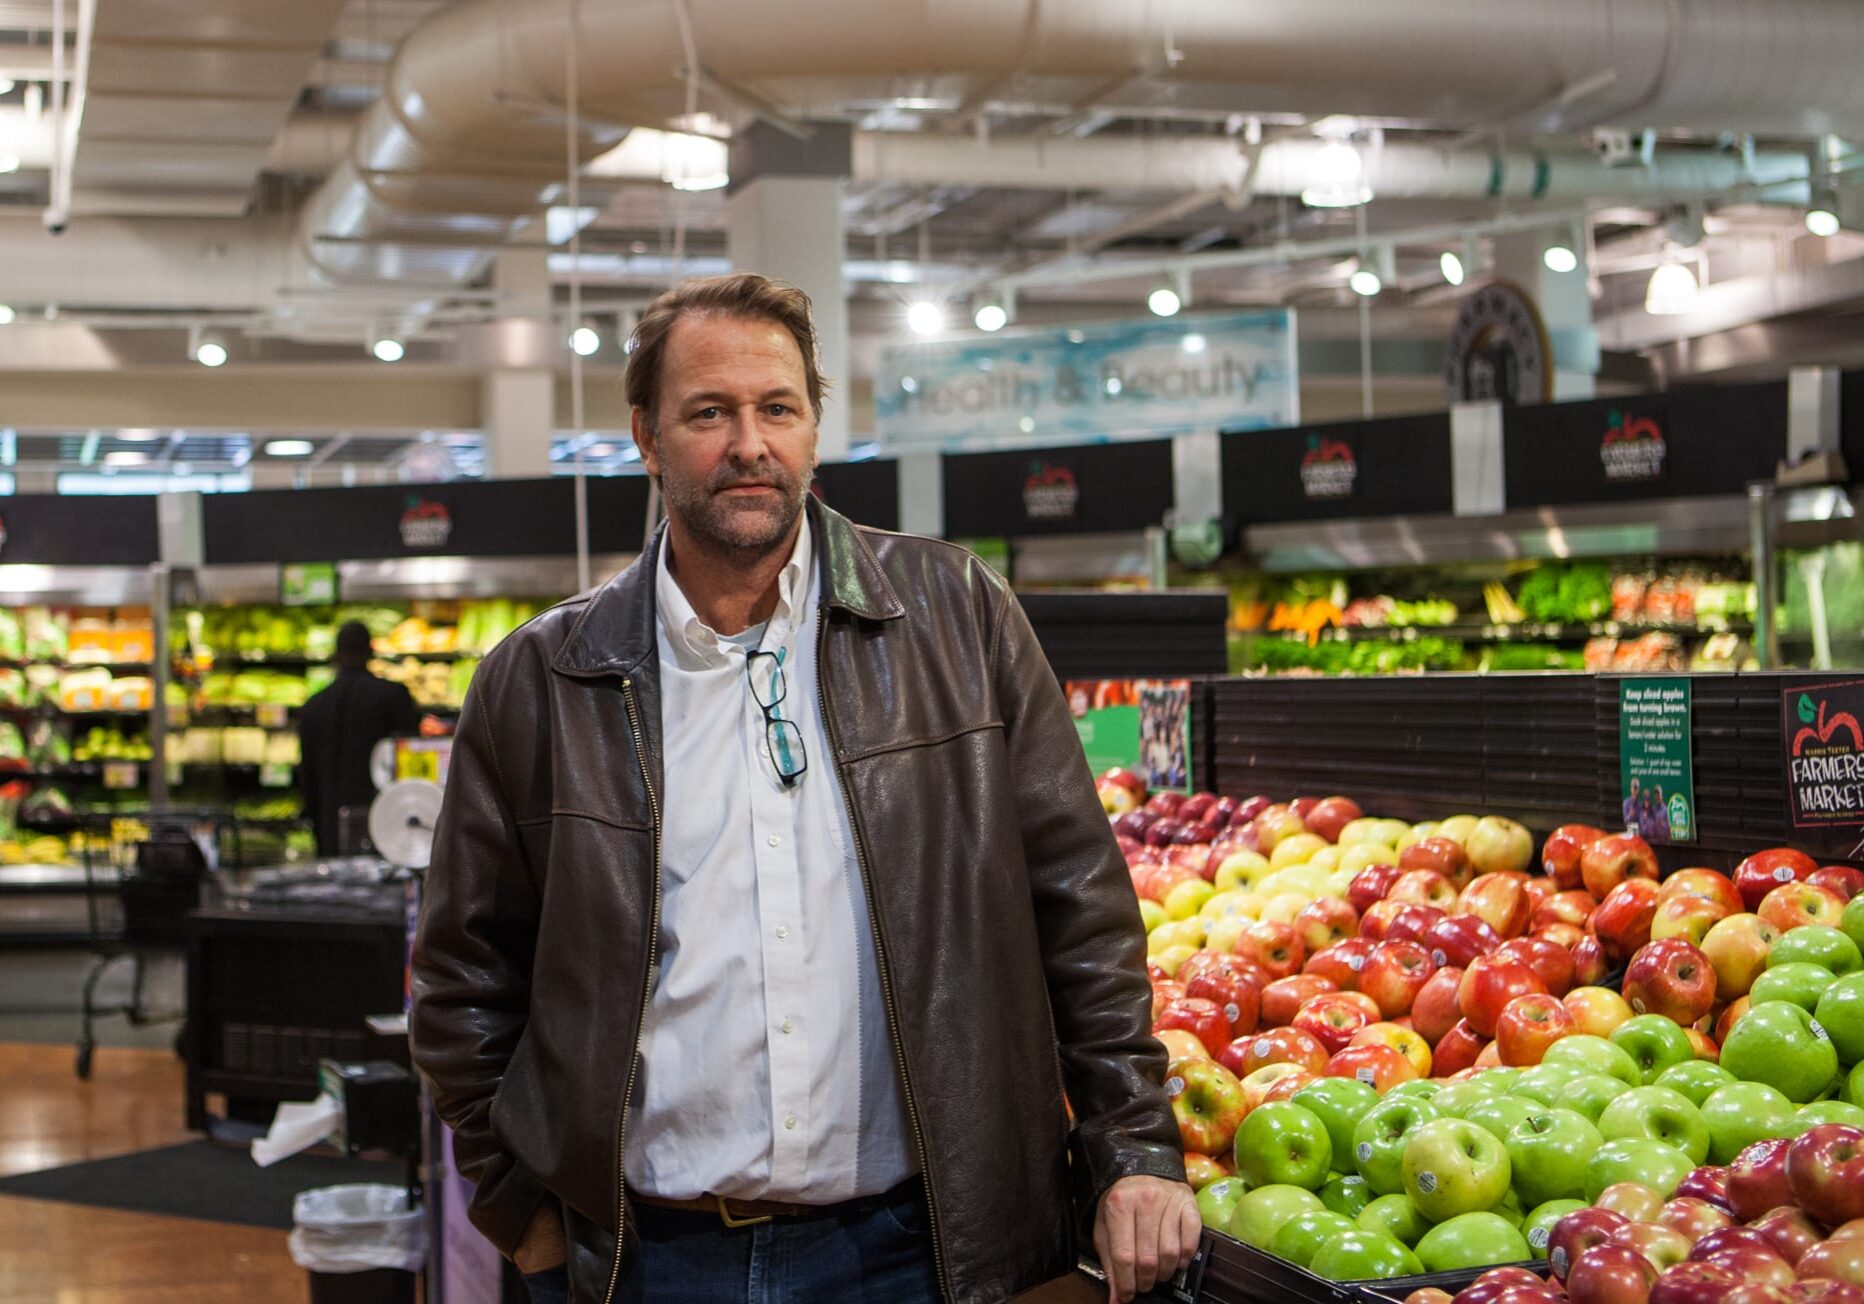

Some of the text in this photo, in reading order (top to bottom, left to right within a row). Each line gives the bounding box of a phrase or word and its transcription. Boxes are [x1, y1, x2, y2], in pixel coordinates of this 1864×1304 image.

[1053, 364, 1085, 407] &
[1102, 352, 1262, 406] Beauty
[1623, 700, 1687, 716] from turning brown.
[1625, 687, 1684, 702] Keep sliced apples
[1792, 754, 1864, 783] FARMERS
[1799, 783, 1864, 811] MARKET
